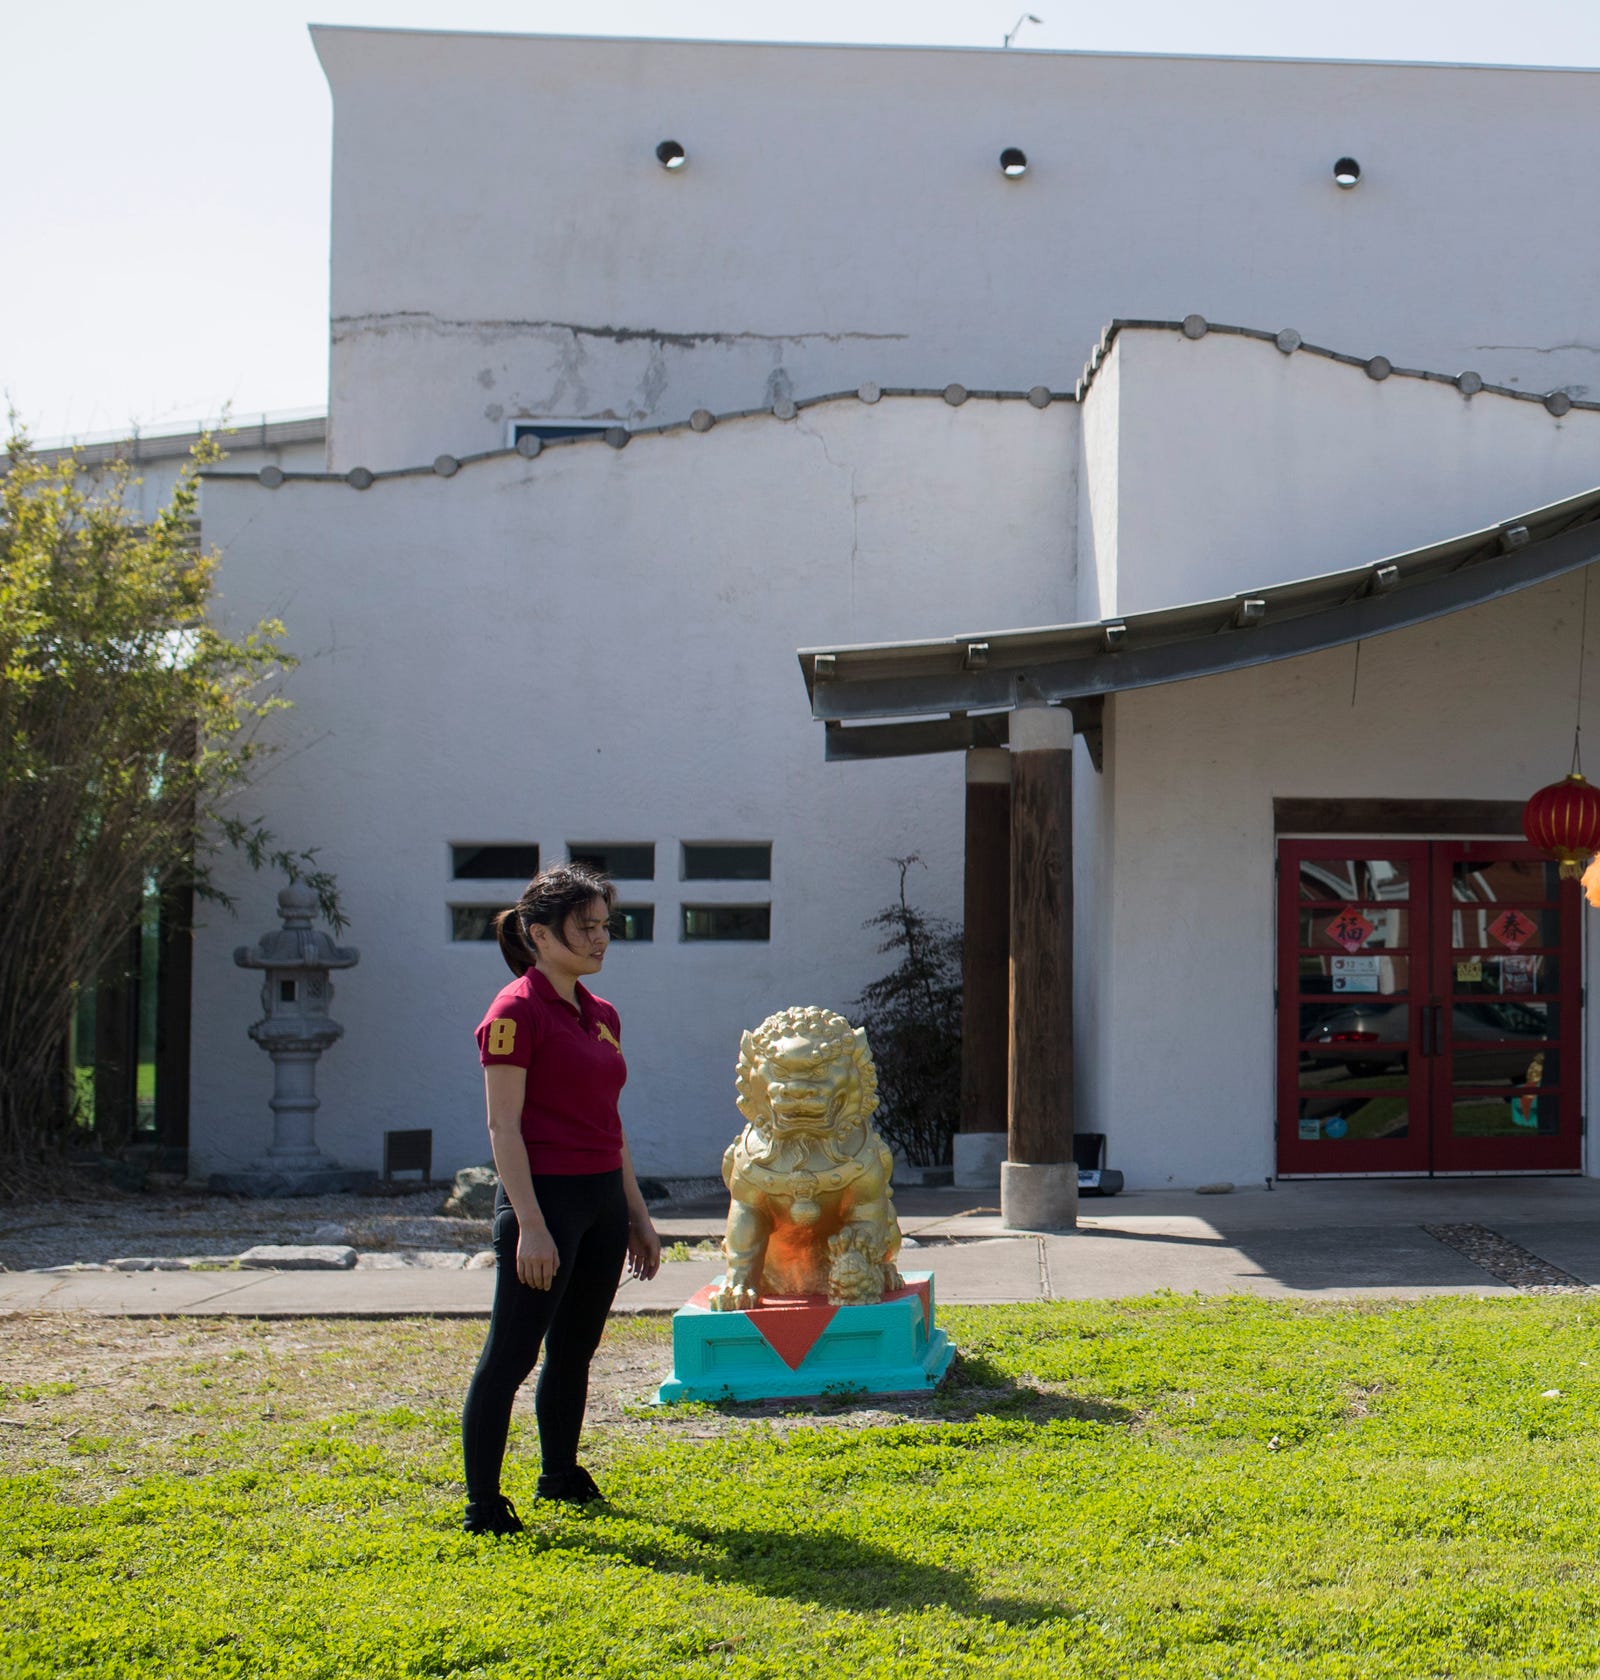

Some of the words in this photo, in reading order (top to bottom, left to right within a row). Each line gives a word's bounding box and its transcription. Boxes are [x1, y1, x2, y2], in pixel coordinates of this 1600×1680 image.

[1336, 916, 1363, 942] 福
[1502, 911, 1527, 941] 春
[488, 1018, 517, 1055] 8
